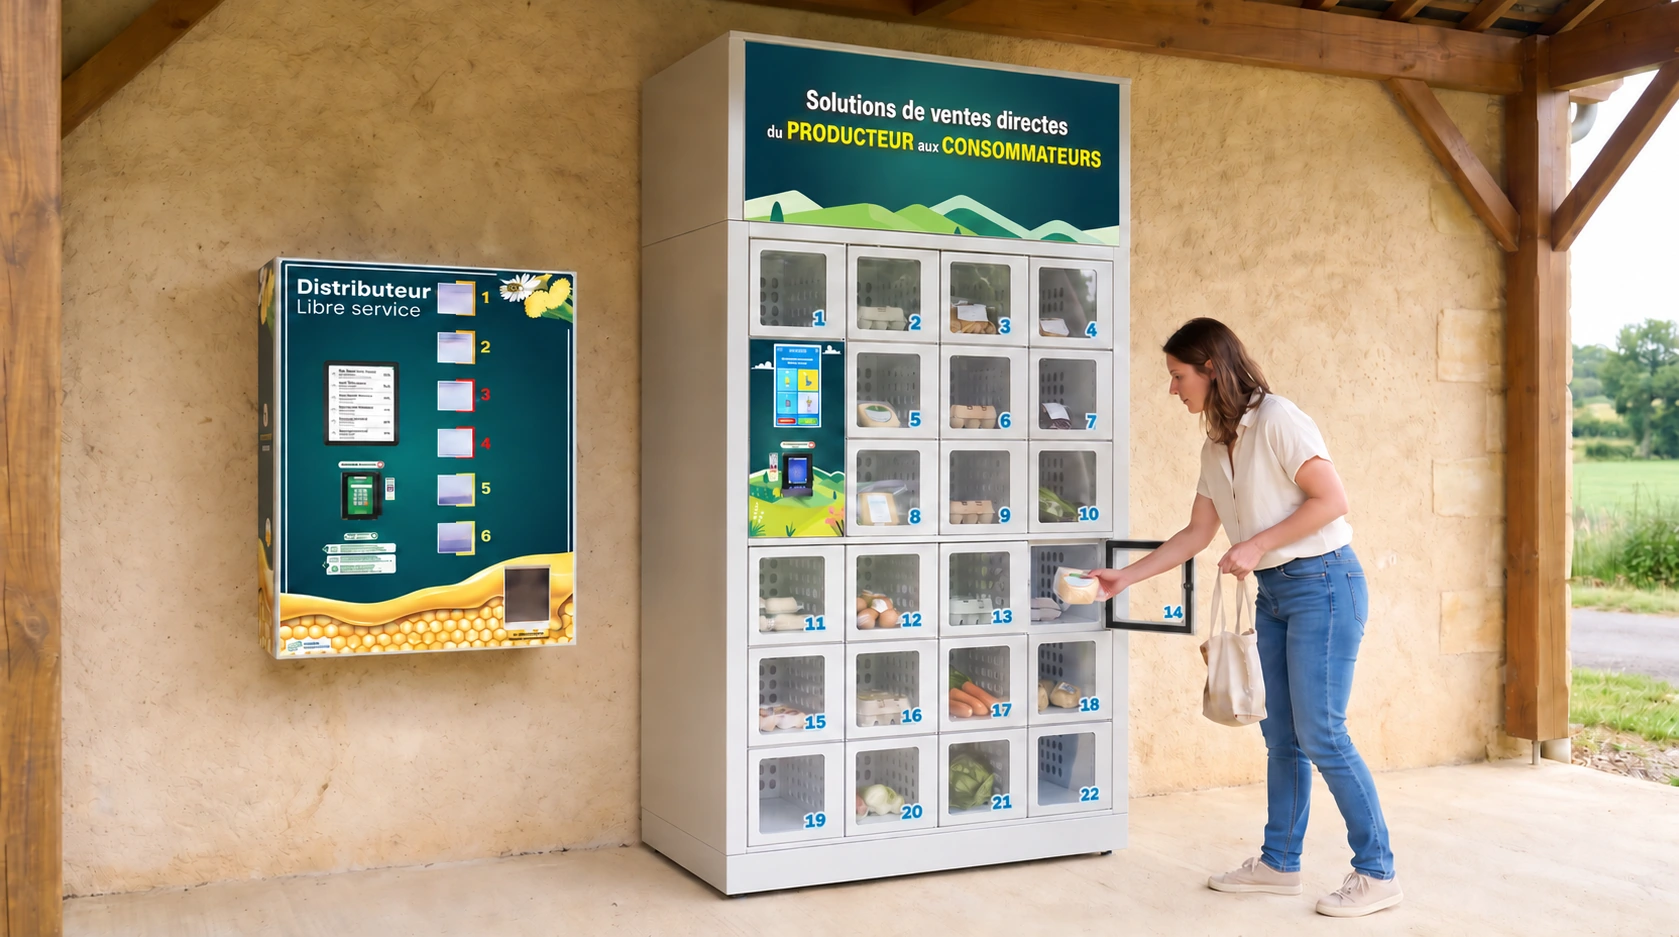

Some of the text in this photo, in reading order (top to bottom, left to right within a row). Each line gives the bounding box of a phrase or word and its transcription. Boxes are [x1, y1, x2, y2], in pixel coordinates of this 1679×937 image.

[806, 89, 1069, 136] Solutions de ventes directes
[767, 120, 1102, 168] du PRODUCTEUR aux CONSOMMATEURS
[297, 278, 432, 299] Distributeur
[481, 291, 490, 304] 1
[297, 299, 421, 317] Libre service
[813, 311, 826, 327] 1
[910, 315, 921, 331] 2
[1000, 319, 1011, 334] 3
[1086, 323, 1098, 337] 4
[480, 340, 491, 354] 2
[480, 388, 491, 402] 3
[910, 412, 921, 427] 5
[1000, 413, 1011, 429] 6
[1086, 414, 1097, 429] 7
[480, 437, 491, 450] 4
[481, 481, 491, 495] 5
[909, 509, 921, 525] 8
[1000, 508, 1011, 523] 9
[1080, 507, 1099, 521] 10
[480, 529, 492, 543] 6
[993, 609, 1013, 624] 13
[1164, 605, 1183, 619] 14
[805, 616, 826, 631] 11
[902, 613, 922, 628] 12
[992, 703, 1012, 718] 17
[1080, 697, 1100, 712] 18
[805, 715, 826, 730] 15
[902, 708, 922, 723] 16
[1081, 787, 1099, 802] 22
[992, 795, 1012, 810] 21
[901, 804, 923, 820] 20
[805, 813, 826, 829] 19
